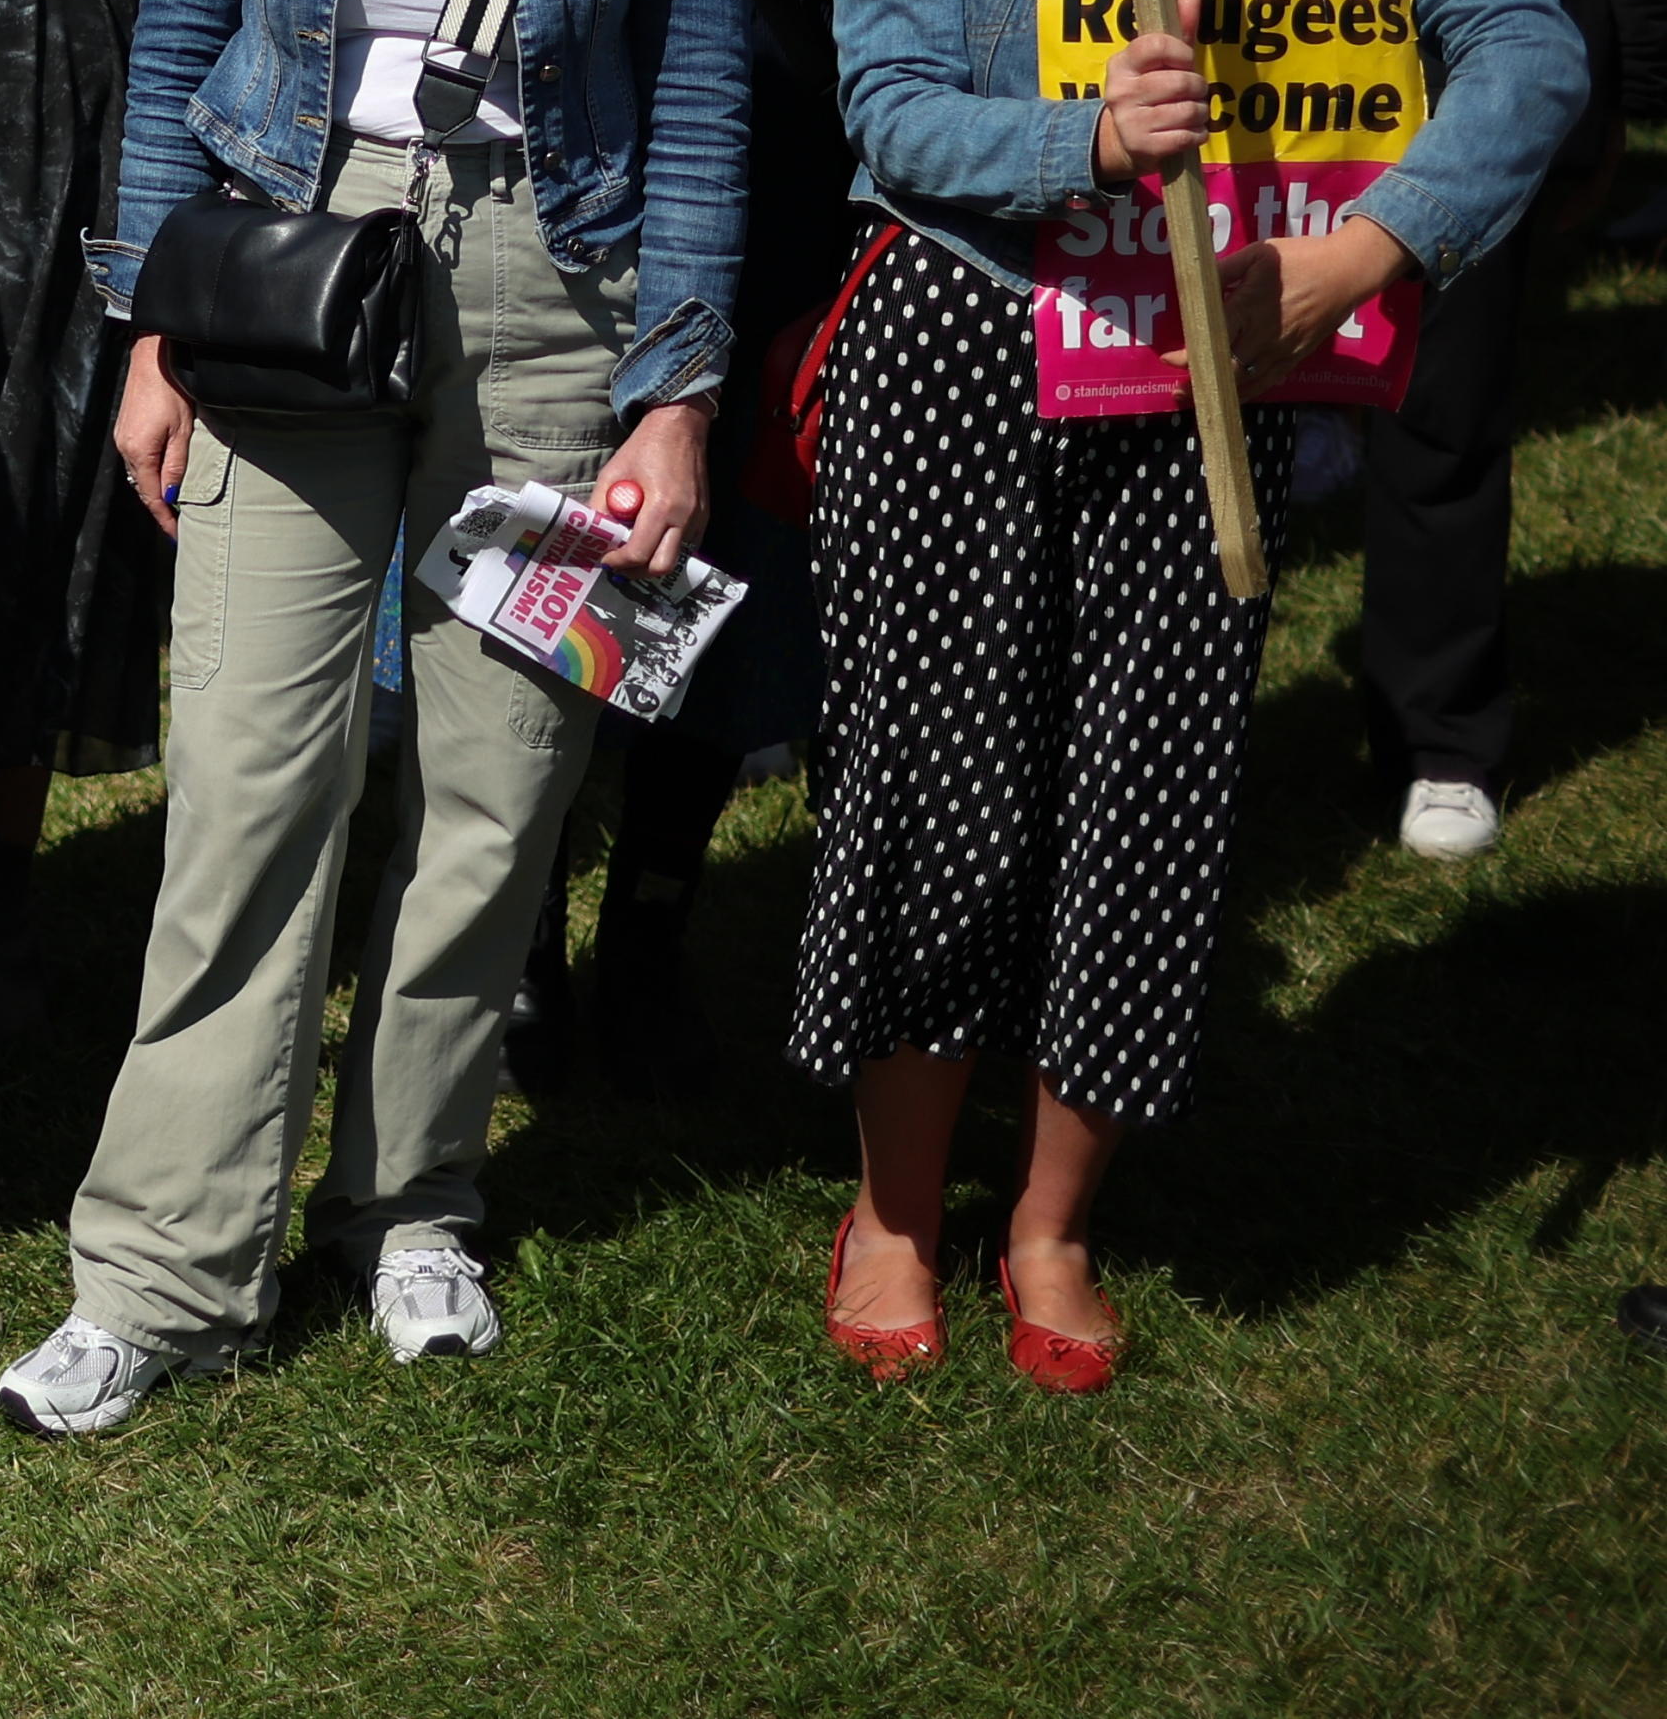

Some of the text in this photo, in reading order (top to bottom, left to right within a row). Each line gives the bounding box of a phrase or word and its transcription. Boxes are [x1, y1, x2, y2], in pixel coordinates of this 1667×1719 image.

[1055, 275, 1166, 350] far
[509, 510, 589, 625] CAPITALISM!
[529, 569, 585, 642] NOT
